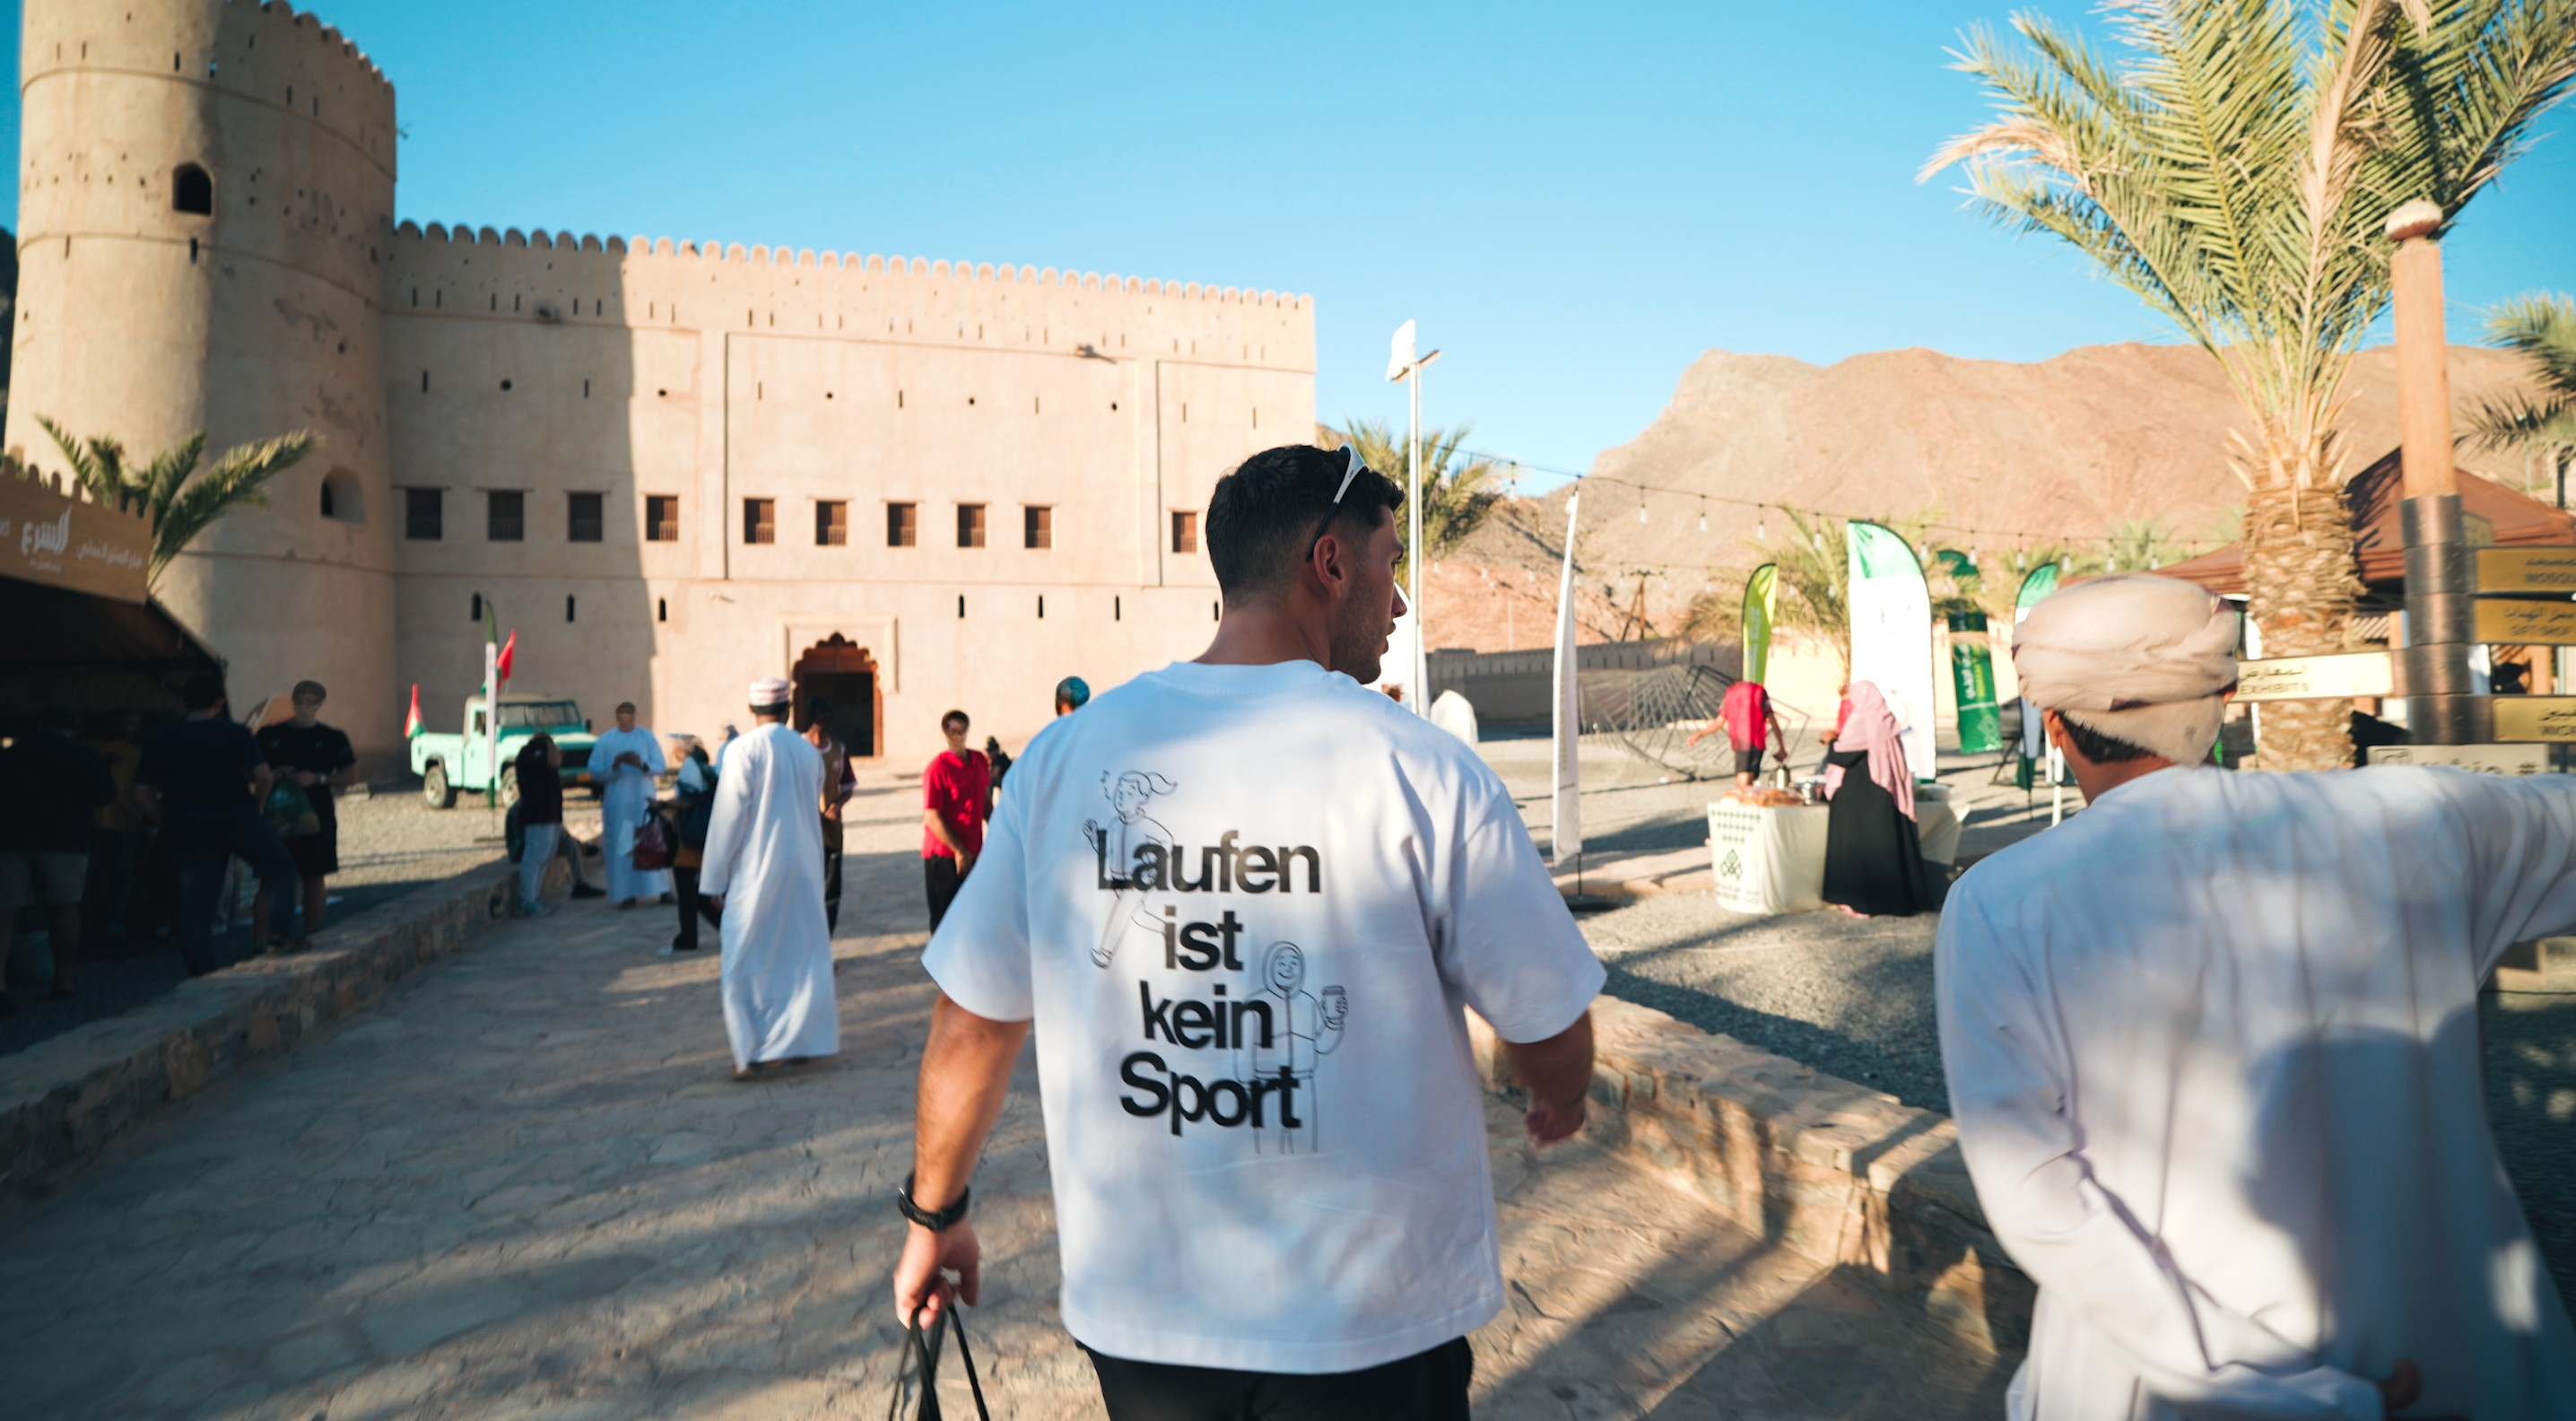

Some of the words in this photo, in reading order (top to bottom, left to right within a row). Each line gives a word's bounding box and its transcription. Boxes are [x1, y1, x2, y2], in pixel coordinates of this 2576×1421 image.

[2240, 682, 2310, 695] EXHIBITS
[1097, 829, 1321, 894] Laufen
[1164, 905, 1244, 971] ist
[1139, 981, 1274, 1050] kein
[1119, 1050, 1302, 1137] Sport
